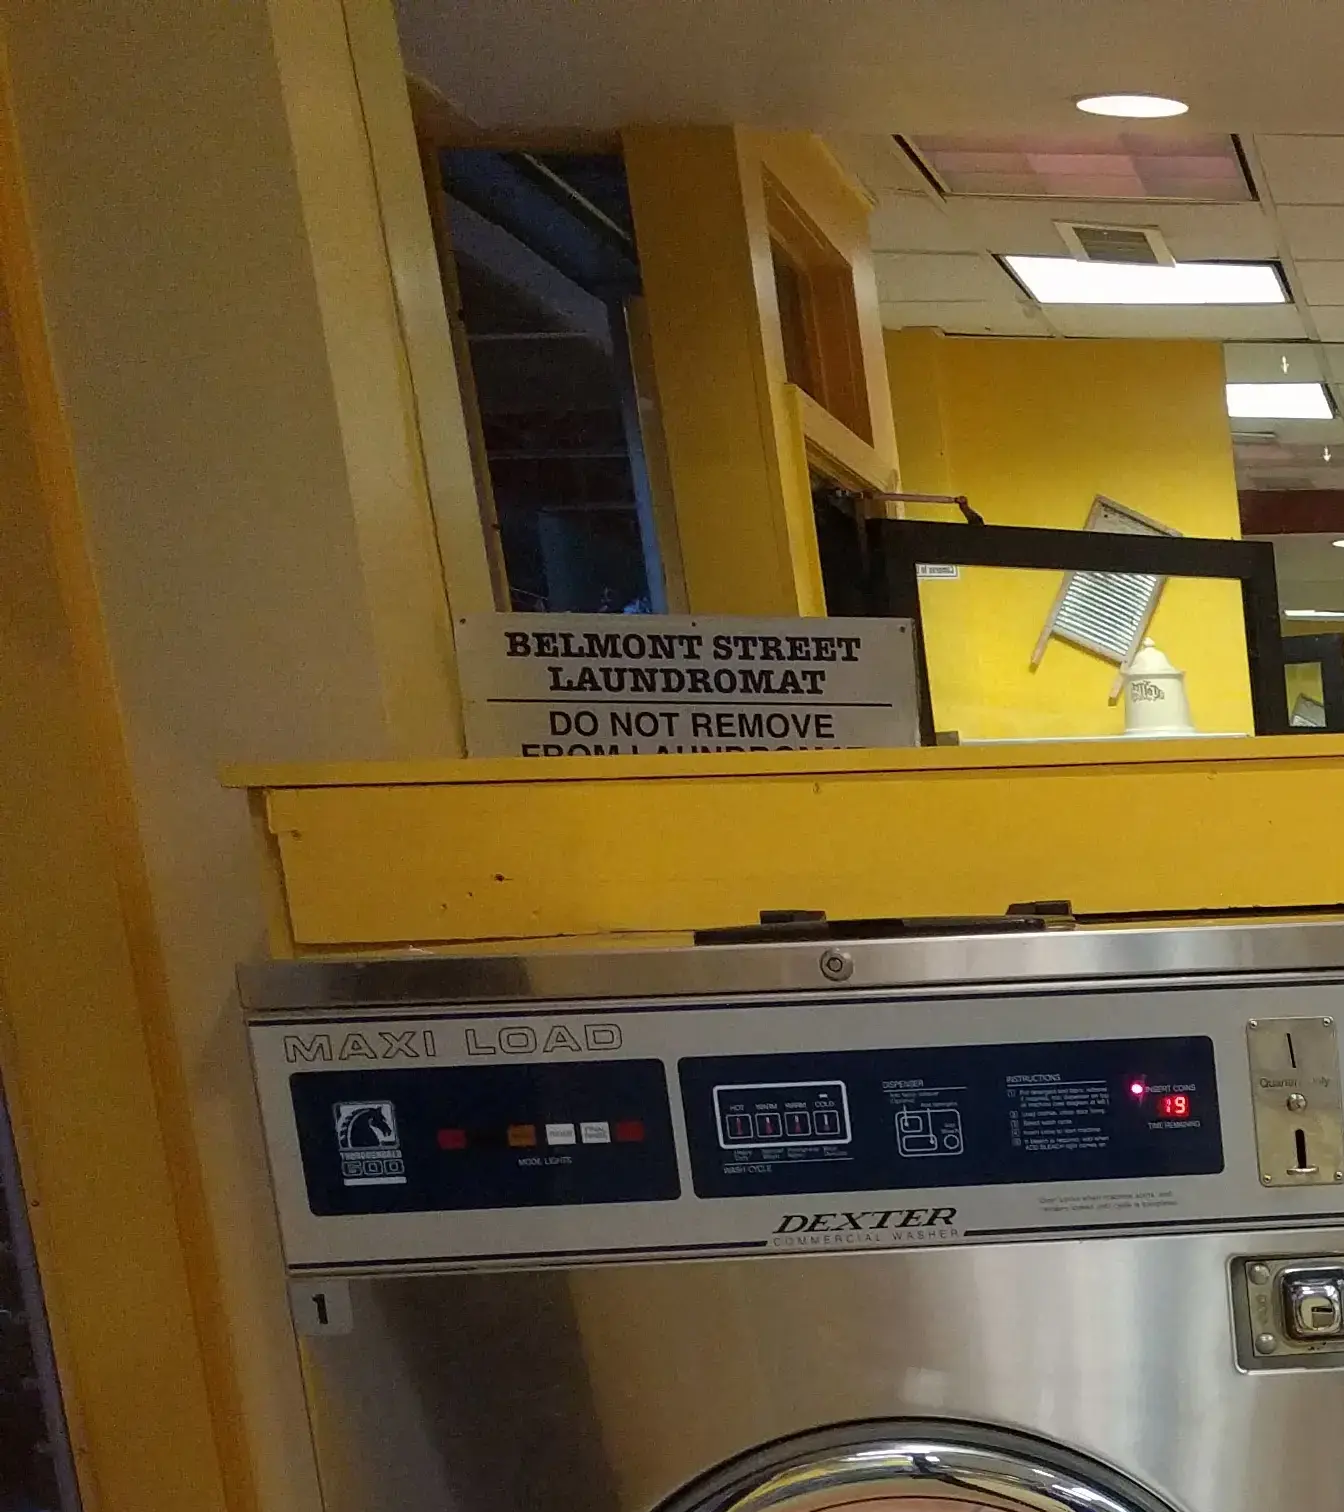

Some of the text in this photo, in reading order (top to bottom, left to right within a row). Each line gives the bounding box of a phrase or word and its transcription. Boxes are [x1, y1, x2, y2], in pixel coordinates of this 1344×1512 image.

[504, 631, 861, 662] BELMONT STREET
[549, 667, 825, 695] LAUNDROMAT
[550, 711, 834, 738] DO NOT REMOVE
[284, 1023, 623, 1062] MAXI LOAD
[1166, 1096, 1186, 1114] 19
[772, 1207, 958, 1234] DEXTER
[773, 1229, 959, 1247] COMMERCIAL WASHER
[312, 1293, 328, 1324] 1
